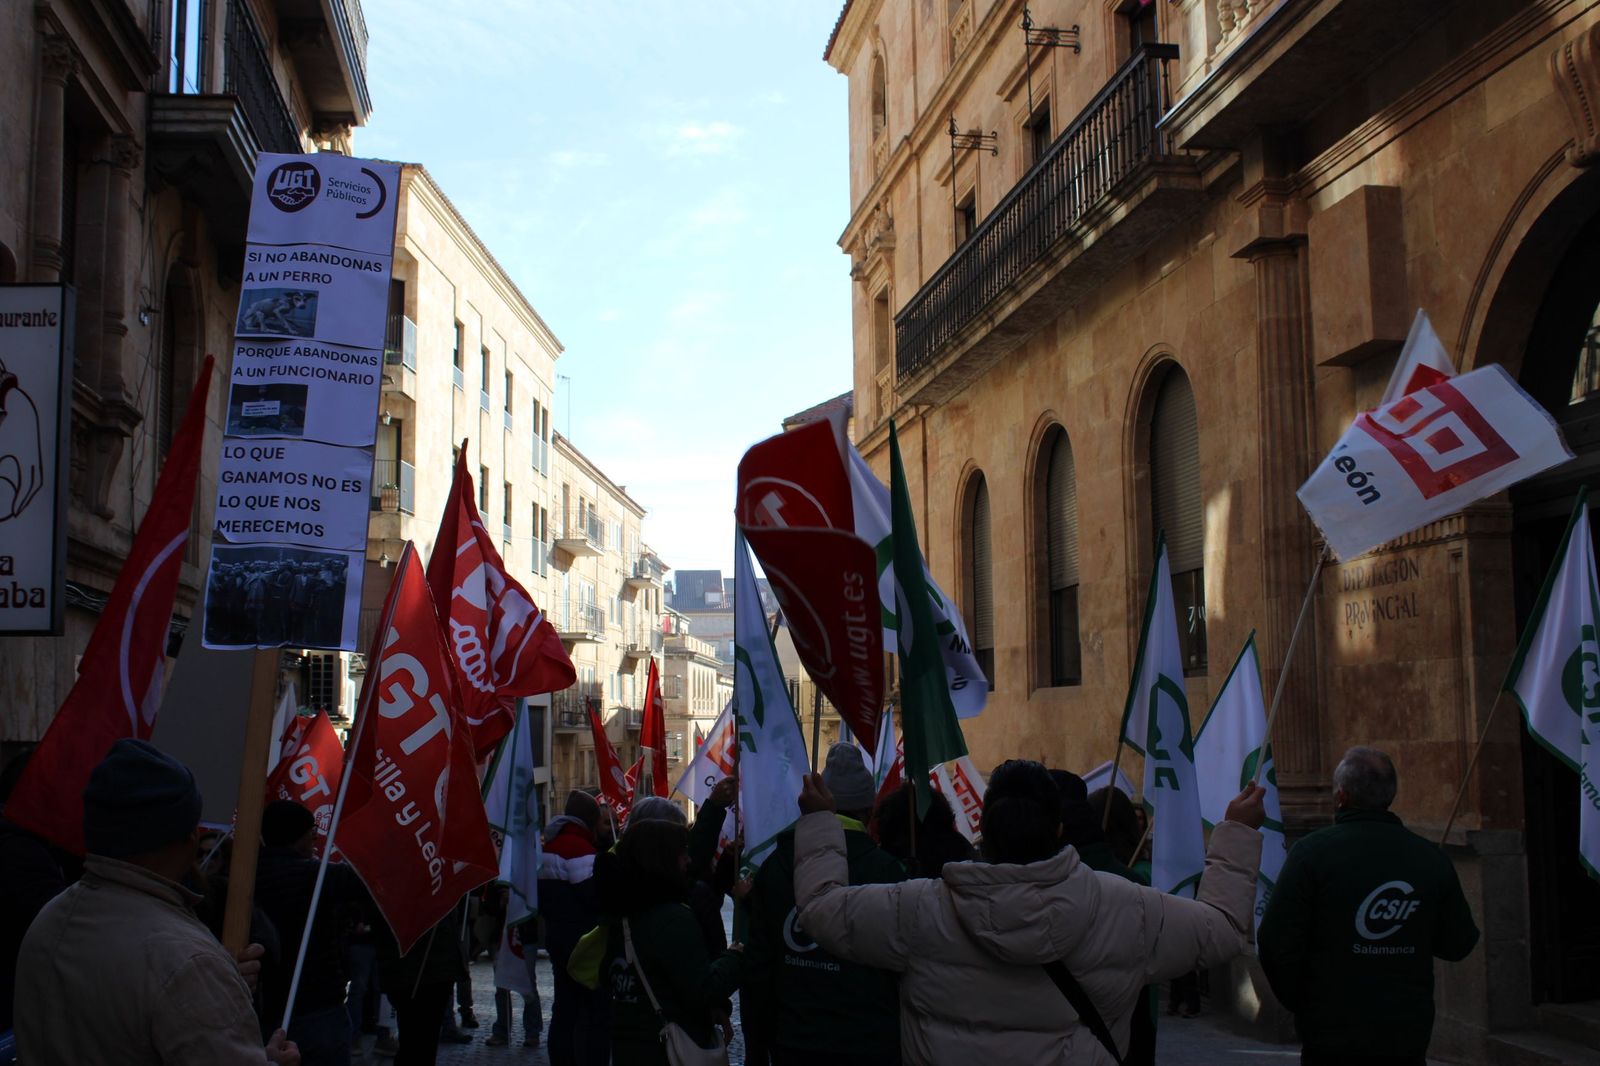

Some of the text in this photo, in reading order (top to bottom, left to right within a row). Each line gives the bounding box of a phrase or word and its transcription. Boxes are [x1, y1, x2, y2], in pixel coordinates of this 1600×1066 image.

[273, 169, 315, 190] UGT
[327, 177, 371, 195] Servicios
[326, 188, 368, 206] Públicos
[248, 251, 383, 273] SI NO ABANDONAS
[244, 270, 333, 285] A UN PERRO
[236, 346, 379, 367] PORQUE ABANDONAS
[233, 365, 375, 386] A UN FUNCIONARIO
[224, 446, 286, 462] LO QUE
[221, 470, 363, 494] GANAMOS NO ES
[219, 495, 321, 512] LO QUE NOS
[217, 519, 325, 538] MERECEMOS
[840, 570, 880, 727] www.ugt.es
[377, 626, 453, 757] GT
[288, 743, 332, 802] GT
[395, 801, 421, 827] y
[414, 821, 448, 896] León
[1352, 943, 1416, 955] Salamanca
[784, 954, 841, 972] Salamanca
